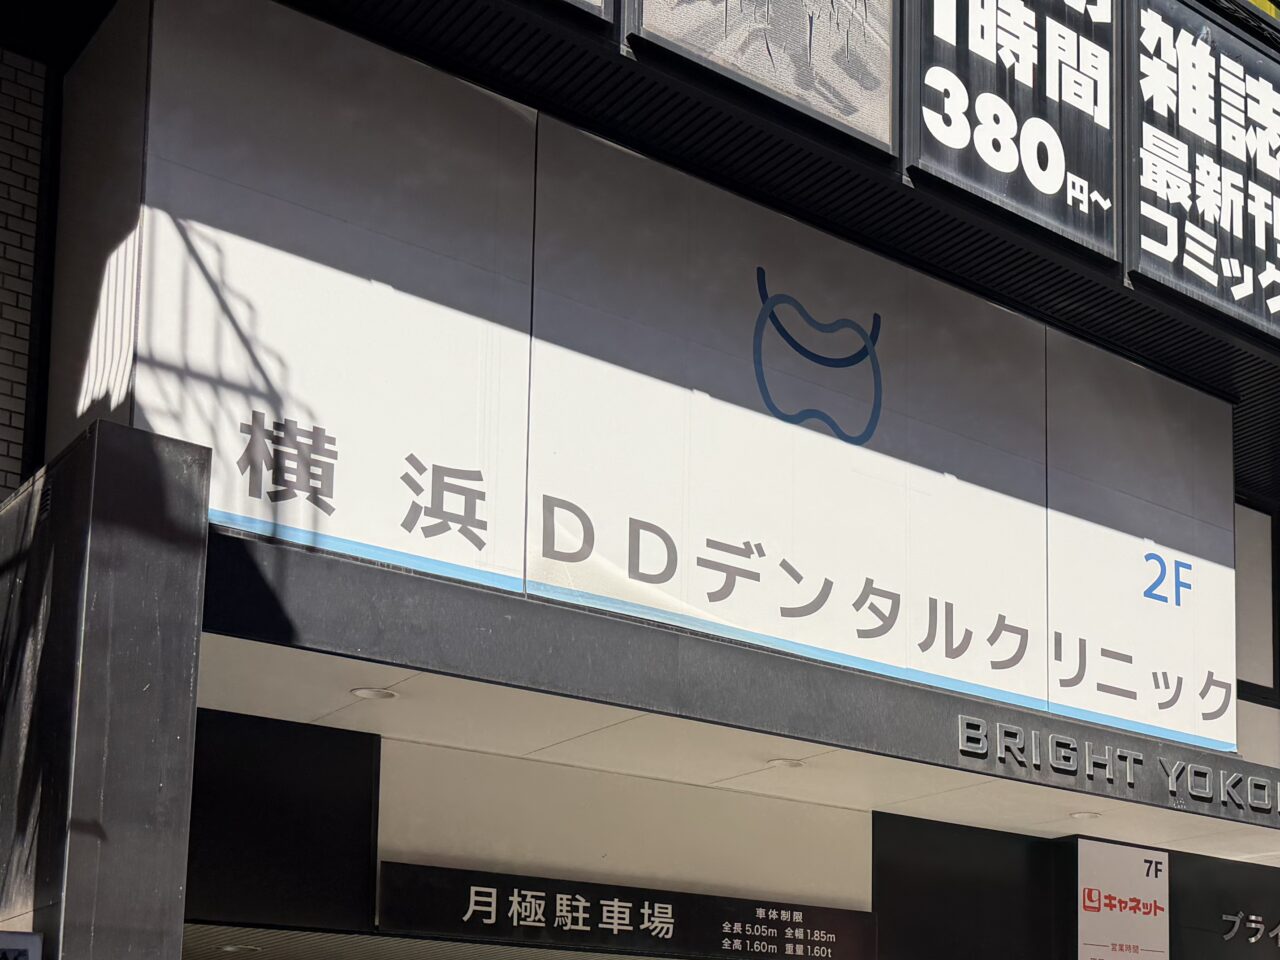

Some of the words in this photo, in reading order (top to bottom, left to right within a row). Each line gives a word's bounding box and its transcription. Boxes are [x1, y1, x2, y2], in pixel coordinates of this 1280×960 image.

[1143, 551, 1194, 607] 2F
[957, 714, 1144, 788] BRIGHT
[1144, 859, 1163, 878] 7F
[462, 885, 675, 940] 月極駐車場
[755, 907, 804, 923] 車体制限
[1103, 894, 1165, 916] キャネット
[722, 921, 742, 934] 全長
[745, 923, 777, 936] 5.05m
[784, 927, 804, 939] 全幅
[806, 929, 836, 942] 1.85m
[721, 938, 742, 950] 全高
[745, 940, 778, 953] 1.60m
[784, 943, 804, 955] 重量
[807, 945, 832, 958] 1.60t
[1110, 943, 1140, 954] 営業時間
